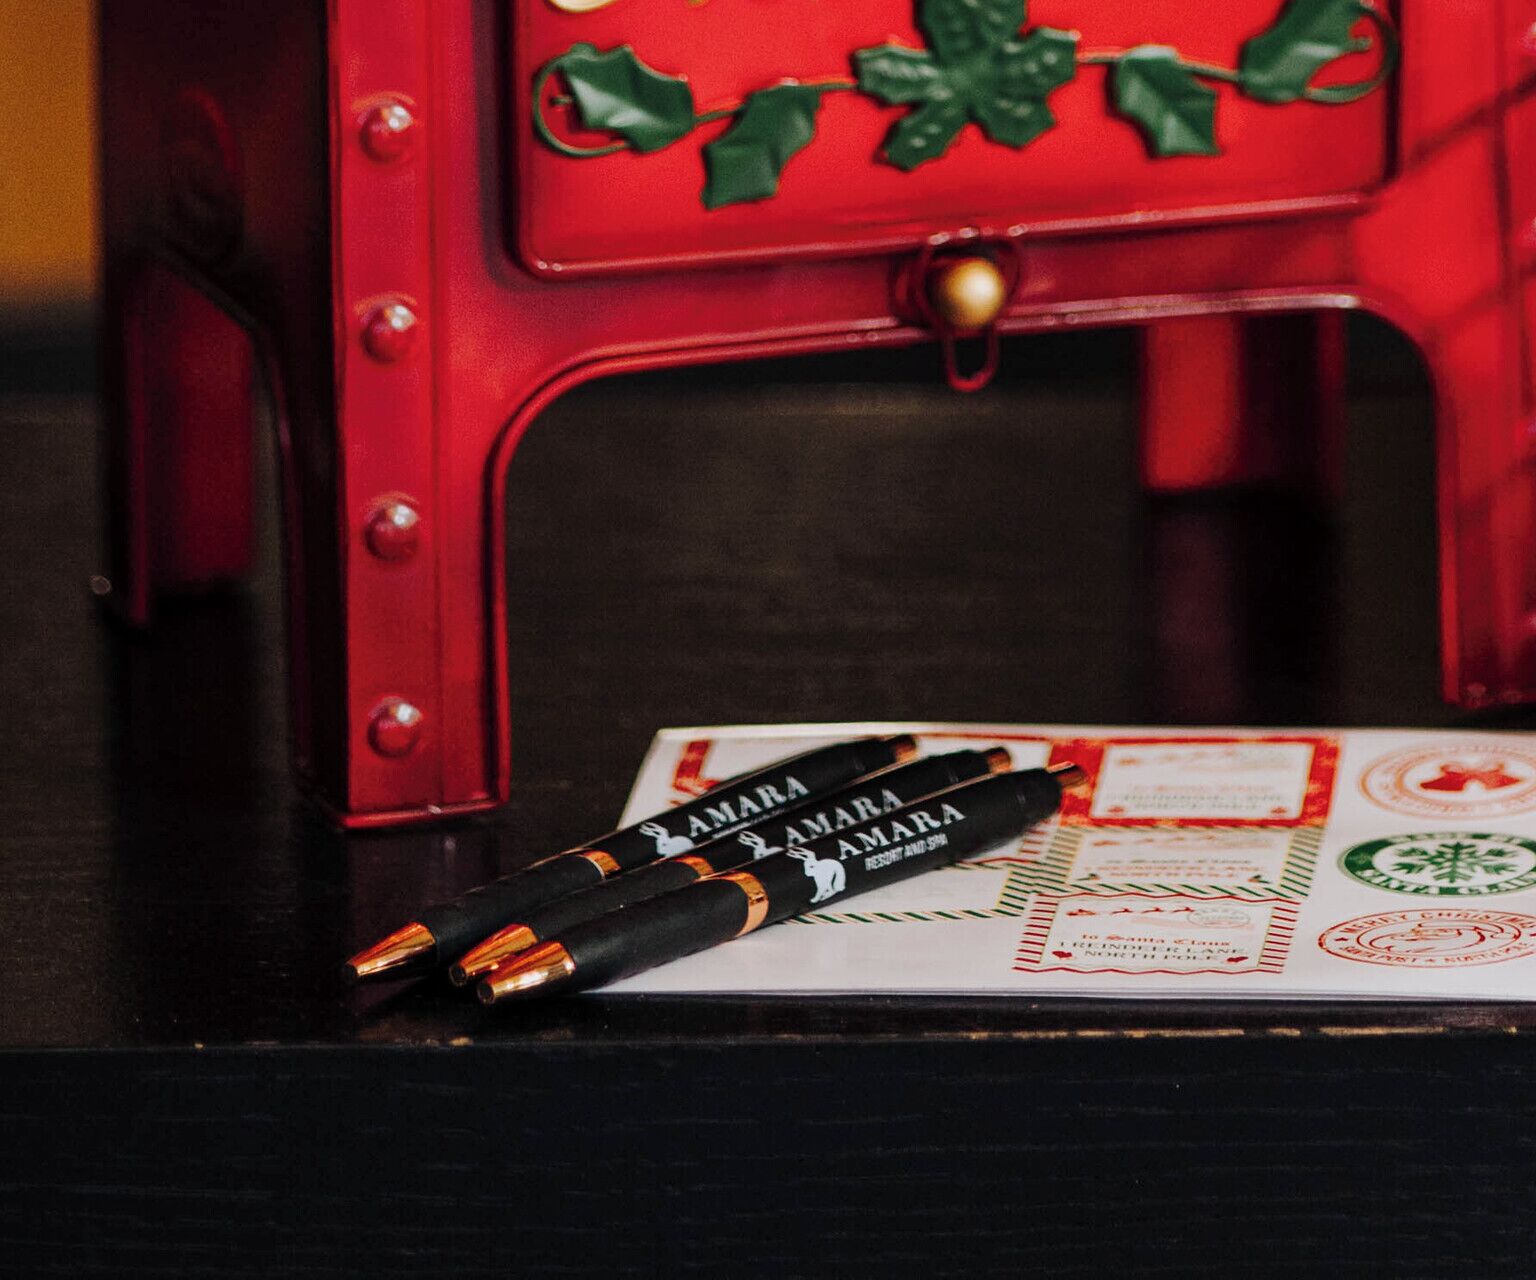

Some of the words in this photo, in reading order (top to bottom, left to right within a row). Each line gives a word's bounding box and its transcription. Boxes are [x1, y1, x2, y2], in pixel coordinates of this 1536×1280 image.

[686, 775, 810, 838] AMARA
[784, 788, 905, 848] AMARA
[838, 803, 967, 860] AMARA
[864, 844, 903, 871] RESORT
[903, 840, 926, 860] AND
[926, 832, 949, 854] SPA
[1339, 912, 1408, 934] MERRY
